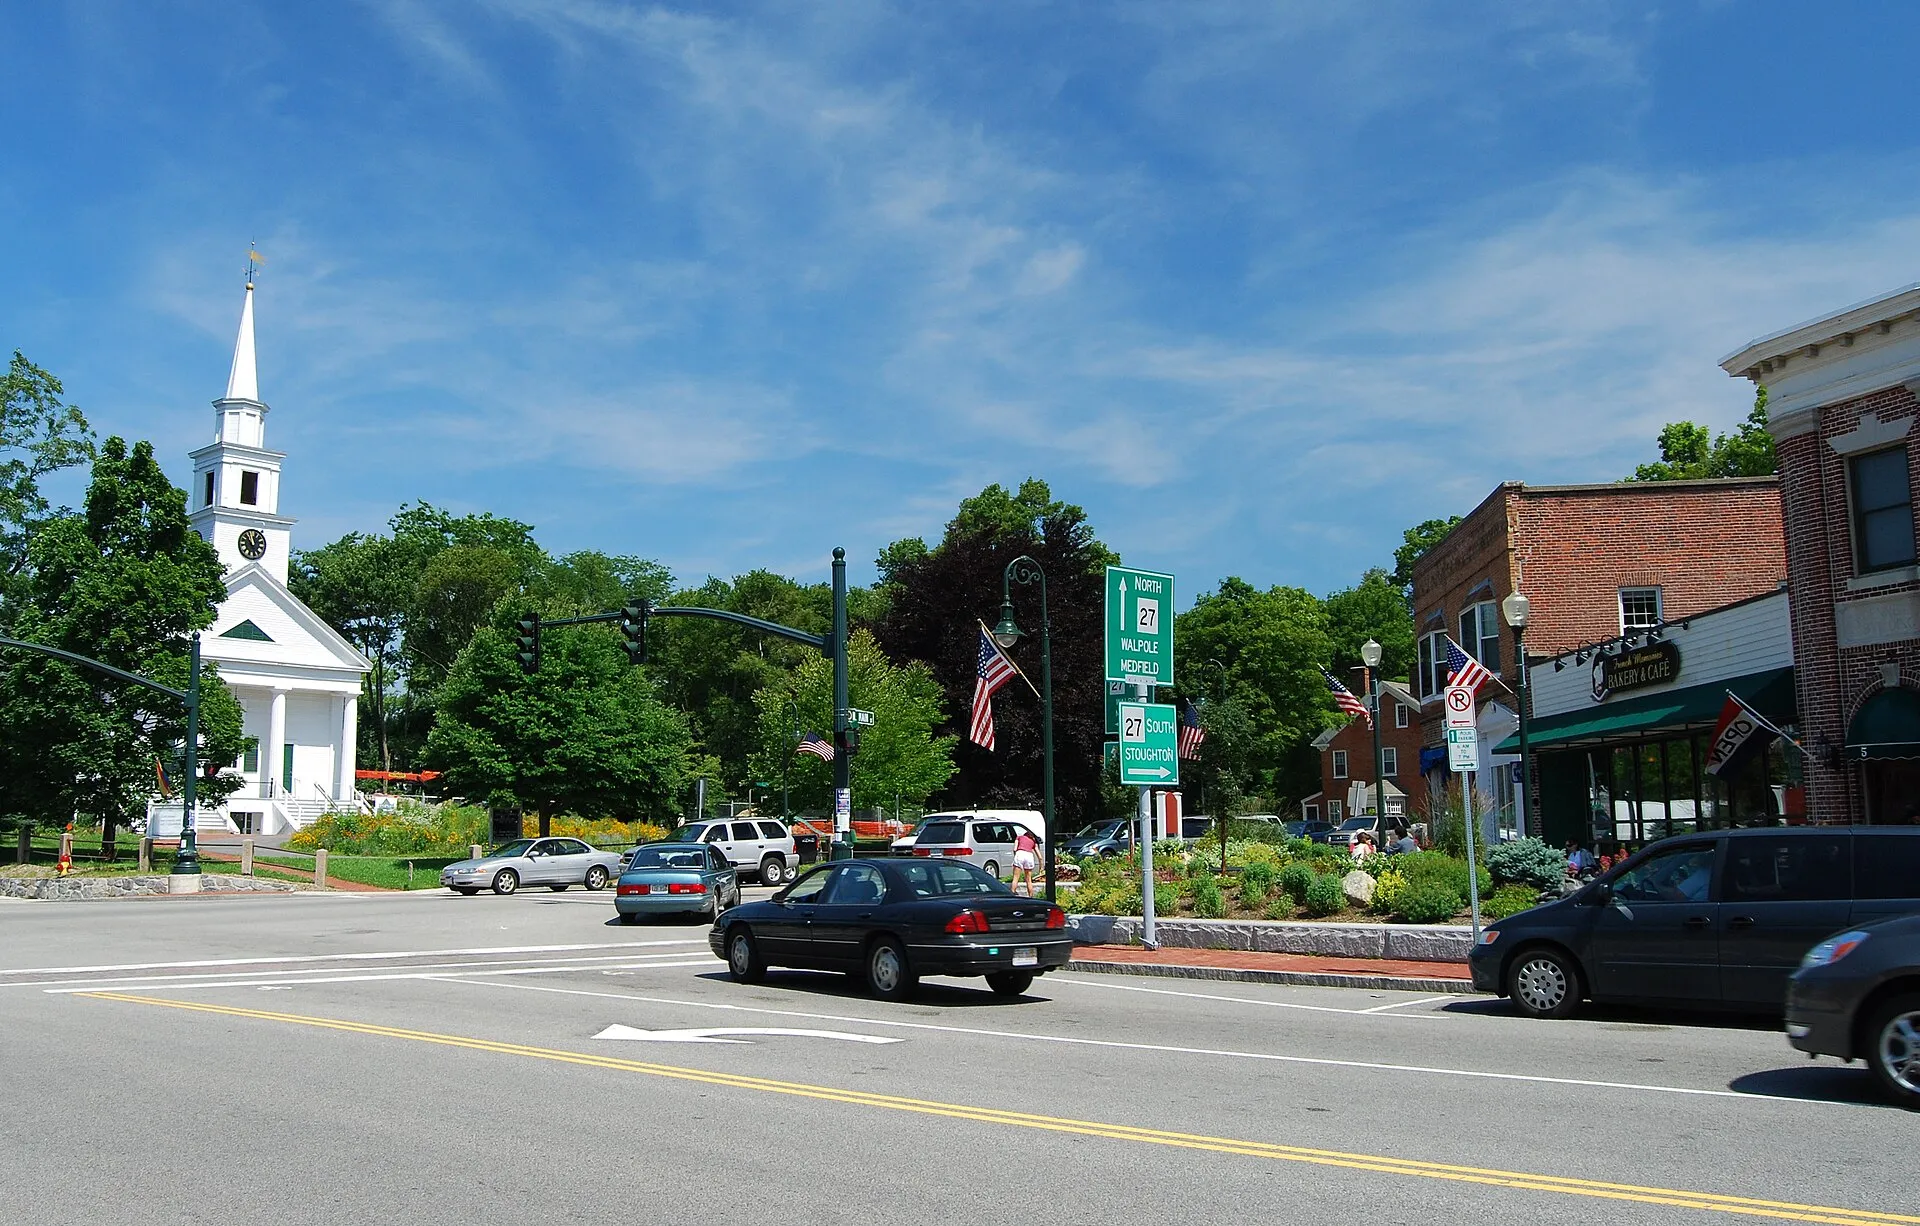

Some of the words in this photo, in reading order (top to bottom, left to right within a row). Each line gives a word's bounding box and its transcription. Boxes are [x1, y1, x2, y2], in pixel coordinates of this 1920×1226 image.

[1134, 575, 1162, 594] NORTH
[1140, 607, 1156, 627] 27
[1120, 637, 1159, 654] WALPOLE
[1120, 658, 1159, 675] MEDFIELD
[1608, 669, 1639, 689] BAKERY
[1640, 667, 1646, 682] &
[1647, 657, 1670, 681] CAFÉ
[1125, 717, 1142, 737] 27
[1146, 718, 1175, 734] SOUTH
[1450, 731, 1455, 742] 1
[1125, 747, 1174, 762] STOUGHTON
[1861, 747, 1867, 757] 5
